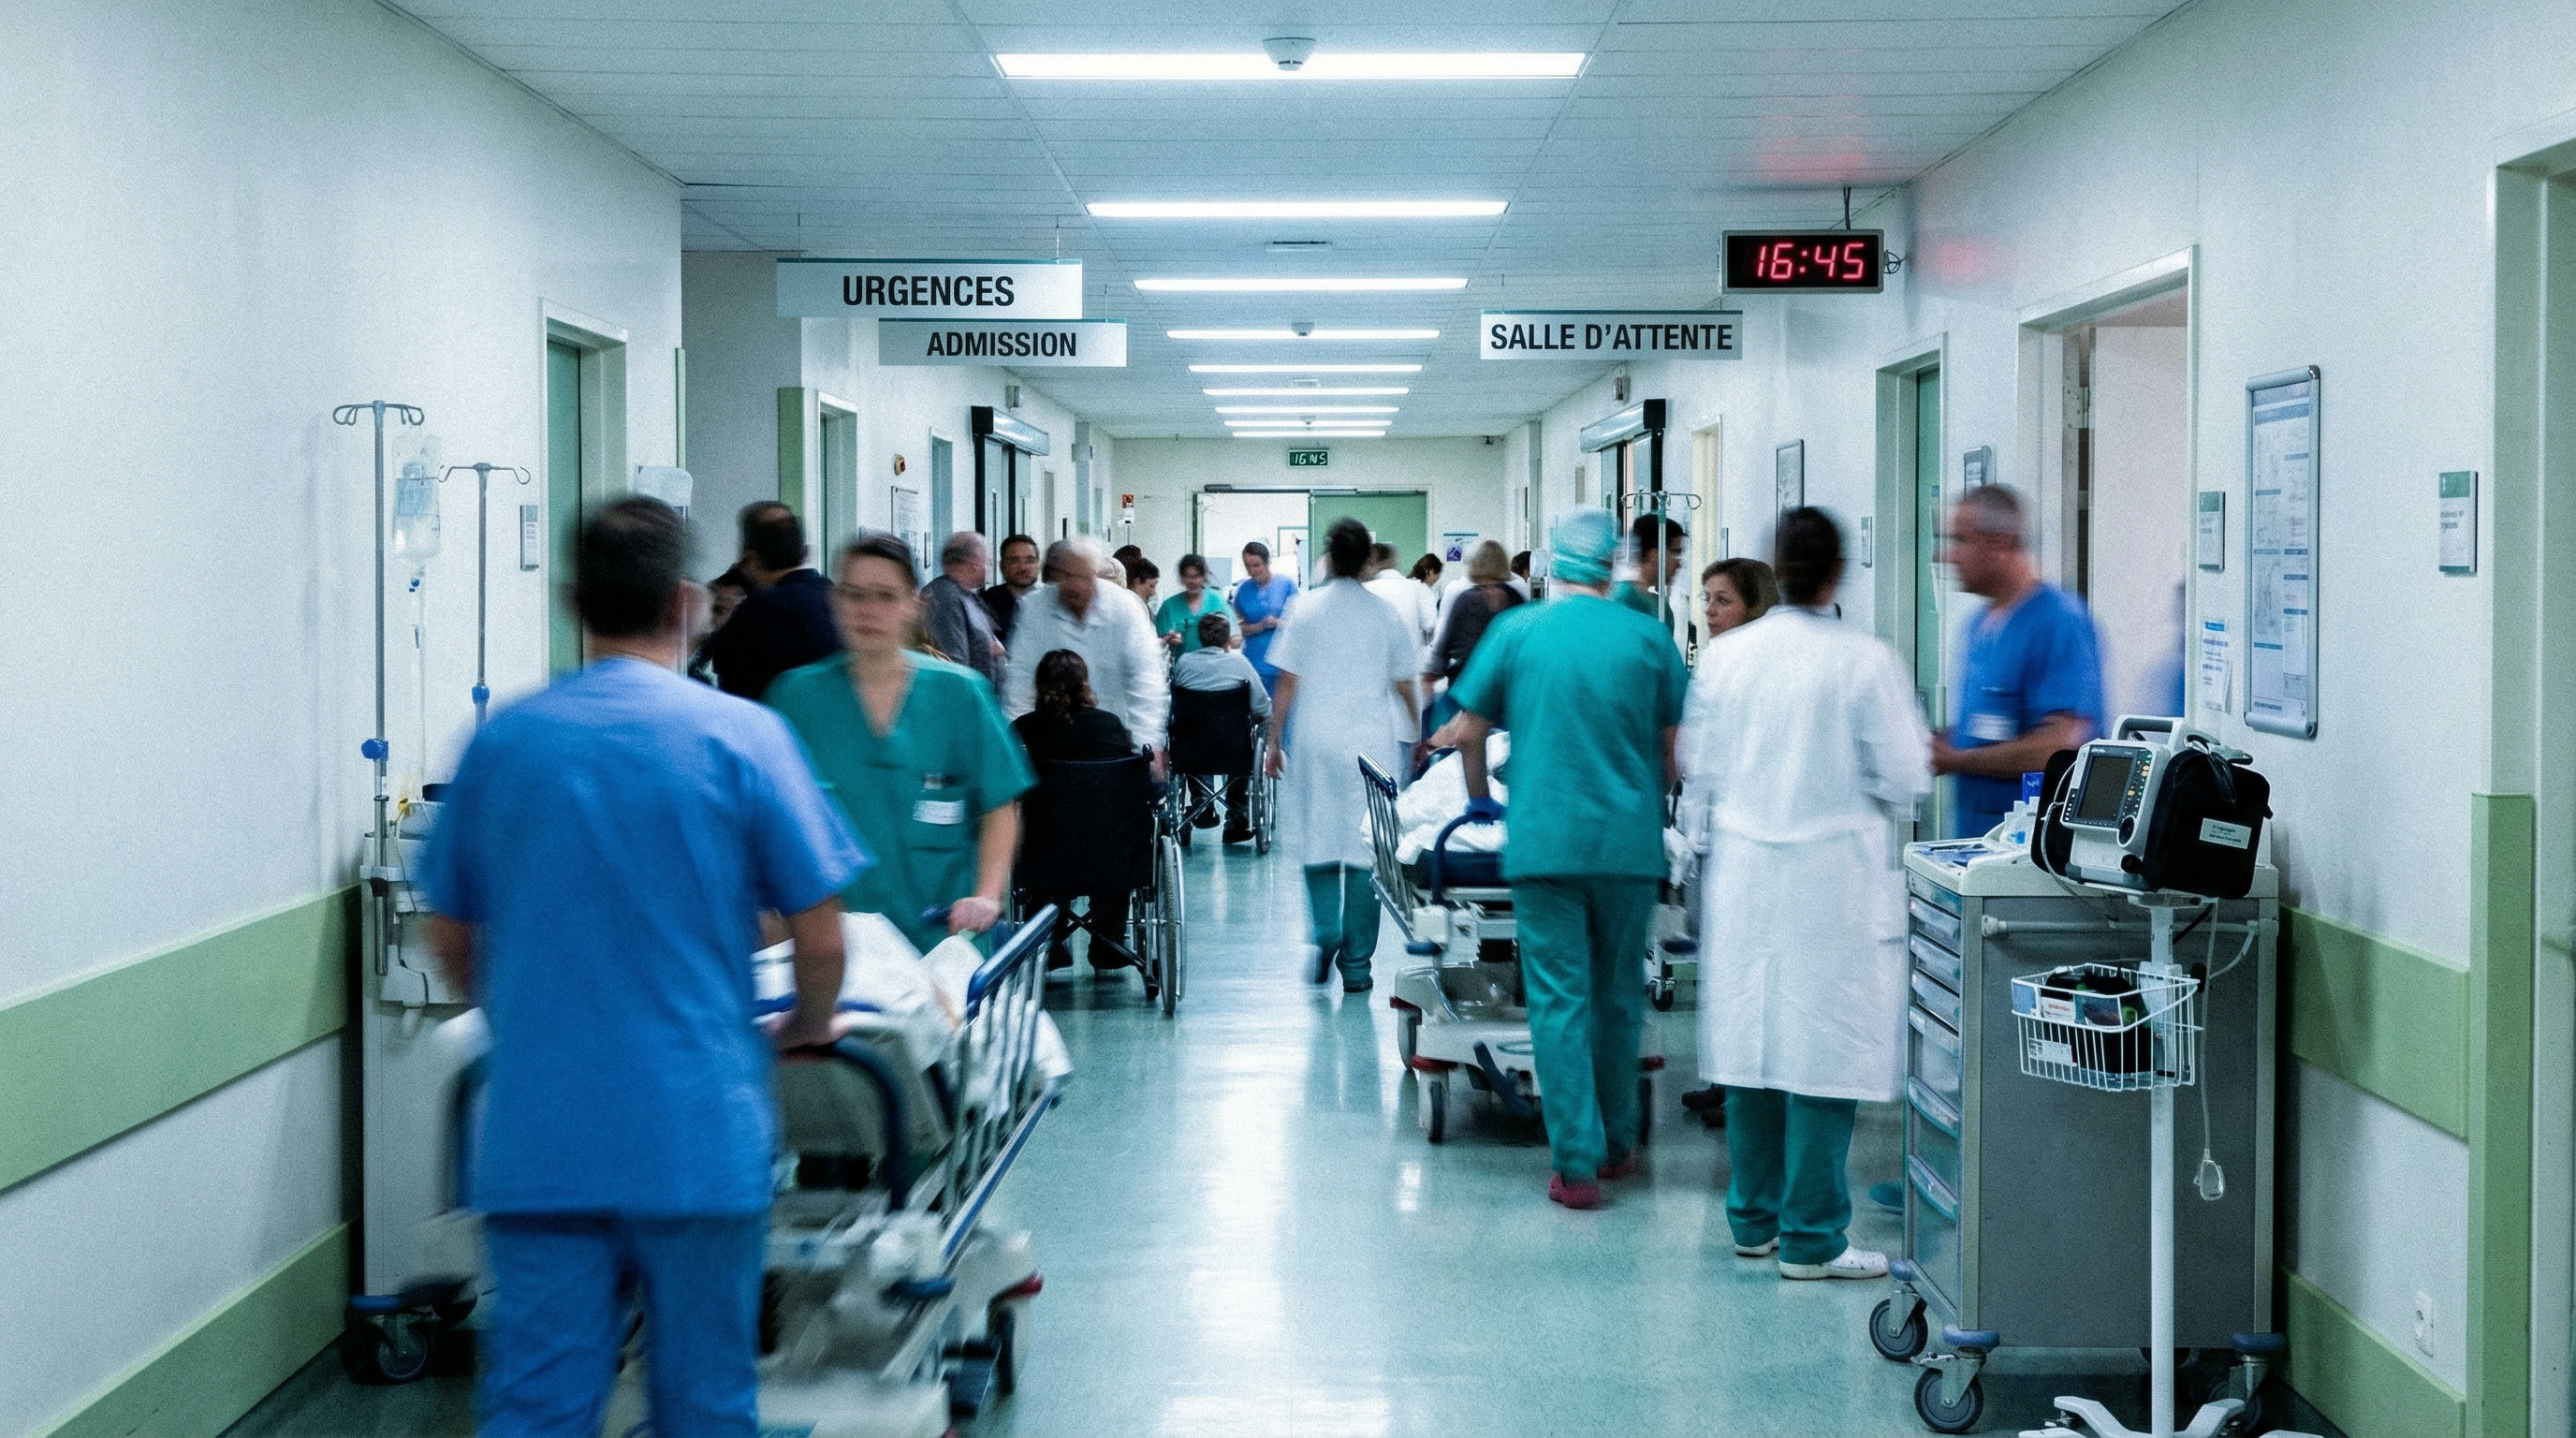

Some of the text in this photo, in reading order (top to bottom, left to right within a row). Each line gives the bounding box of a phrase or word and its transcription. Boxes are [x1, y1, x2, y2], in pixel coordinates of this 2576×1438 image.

[1757, 242, 1865, 280] 16:45
[842, 275, 1015, 307] URGENCES
[926, 331, 1076, 358] ADMISSION
[1491, 323, 1733, 350] SALLE D'ATTENTE
